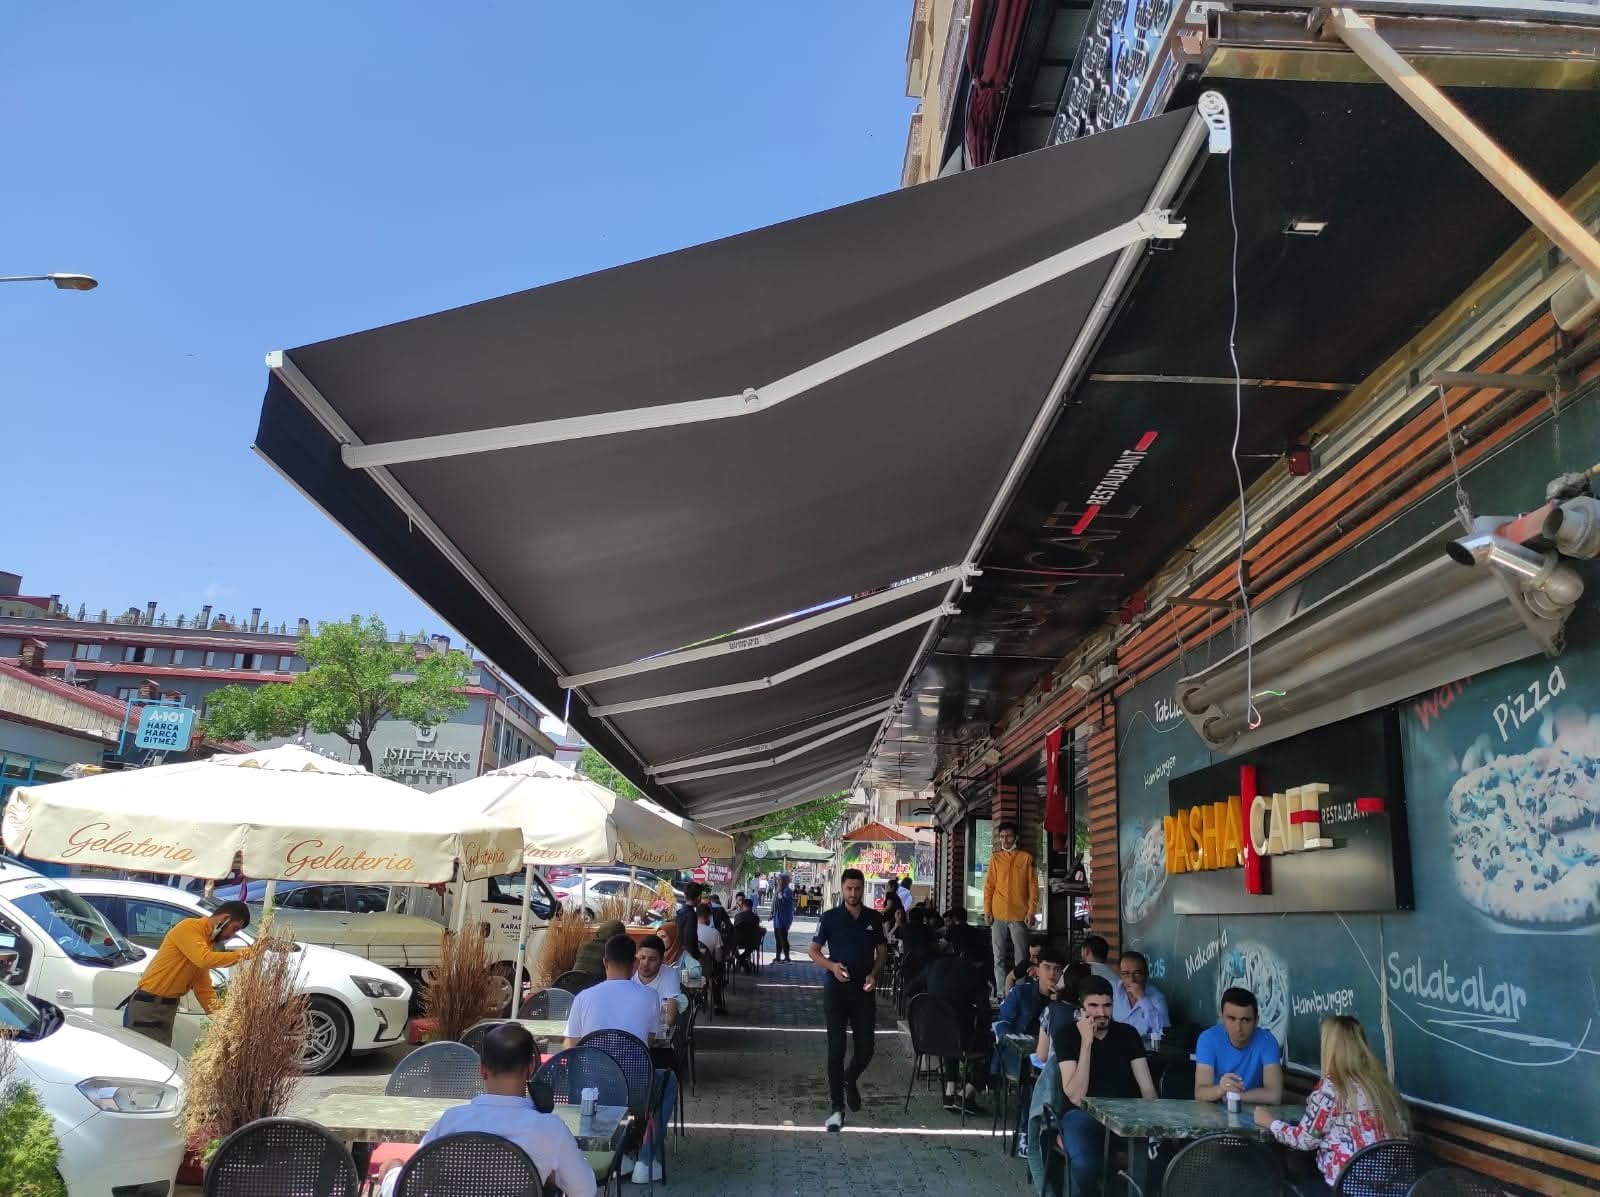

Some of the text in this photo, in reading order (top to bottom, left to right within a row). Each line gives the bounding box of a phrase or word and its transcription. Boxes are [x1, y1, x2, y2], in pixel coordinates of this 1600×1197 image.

[1086, 449, 1148, 505] RESTAURANT
[1493, 665, 1566, 743] Pizza
[145, 729, 178, 739] HARCA
[147, 721, 179, 731] HARCA
[422, 748, 469, 763] PARK
[61, 822, 197, 863] Gelateria
[1163, 795, 1245, 874] PASHA
[1250, 782, 1334, 857] CAFE
[284, 839, 415, 877] Gelateria
[1292, 988, 1355, 1017] Hamburger
[1388, 951, 1527, 1020] Salatalar
